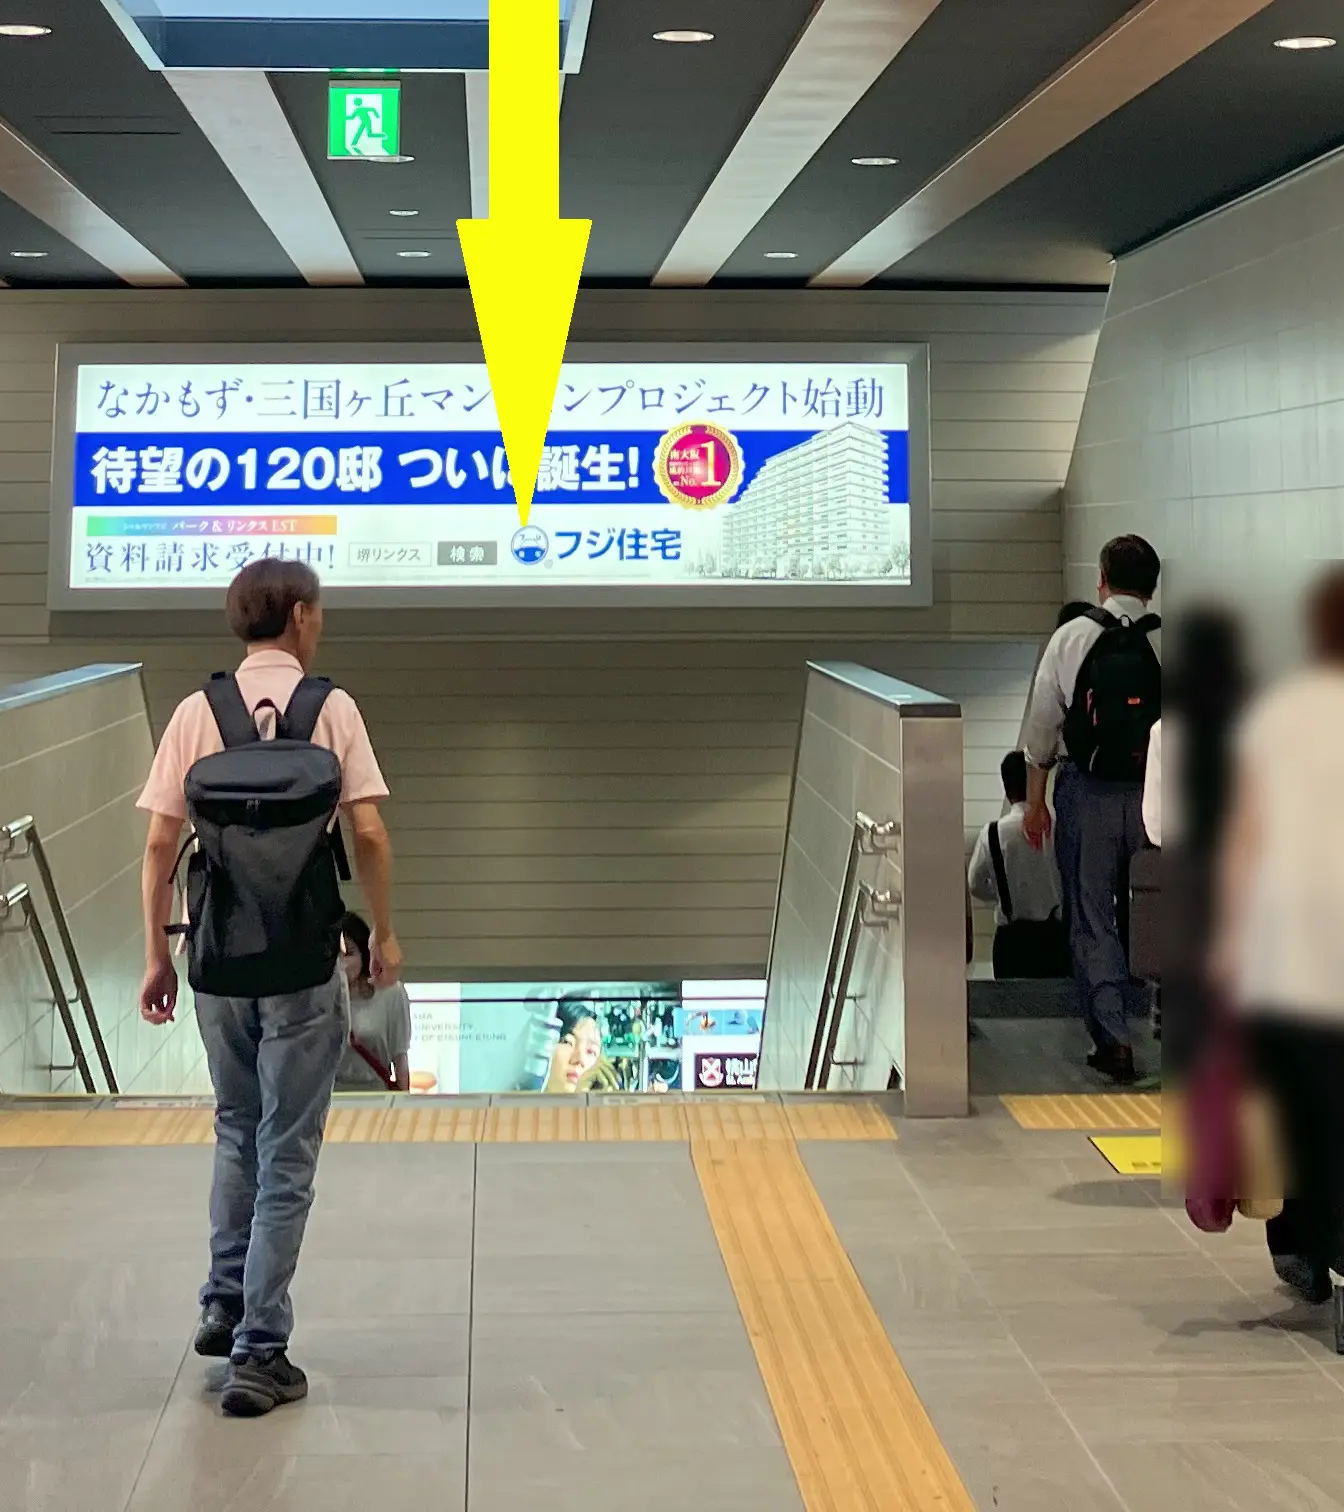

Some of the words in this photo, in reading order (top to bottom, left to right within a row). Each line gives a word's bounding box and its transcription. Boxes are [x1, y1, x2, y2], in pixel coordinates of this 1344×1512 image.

[90, 445, 383, 494] 待望の120邸
[700, 440, 722, 487] 1
[212, 520, 223, 533] &
[227, 520, 268, 533] リンクス
[272, 520, 297, 533] EST
[356, 546, 422, 563] 堺リンクス
[449, 545, 485, 563] 検索
[554, 527, 682, 562] フジ住宅
